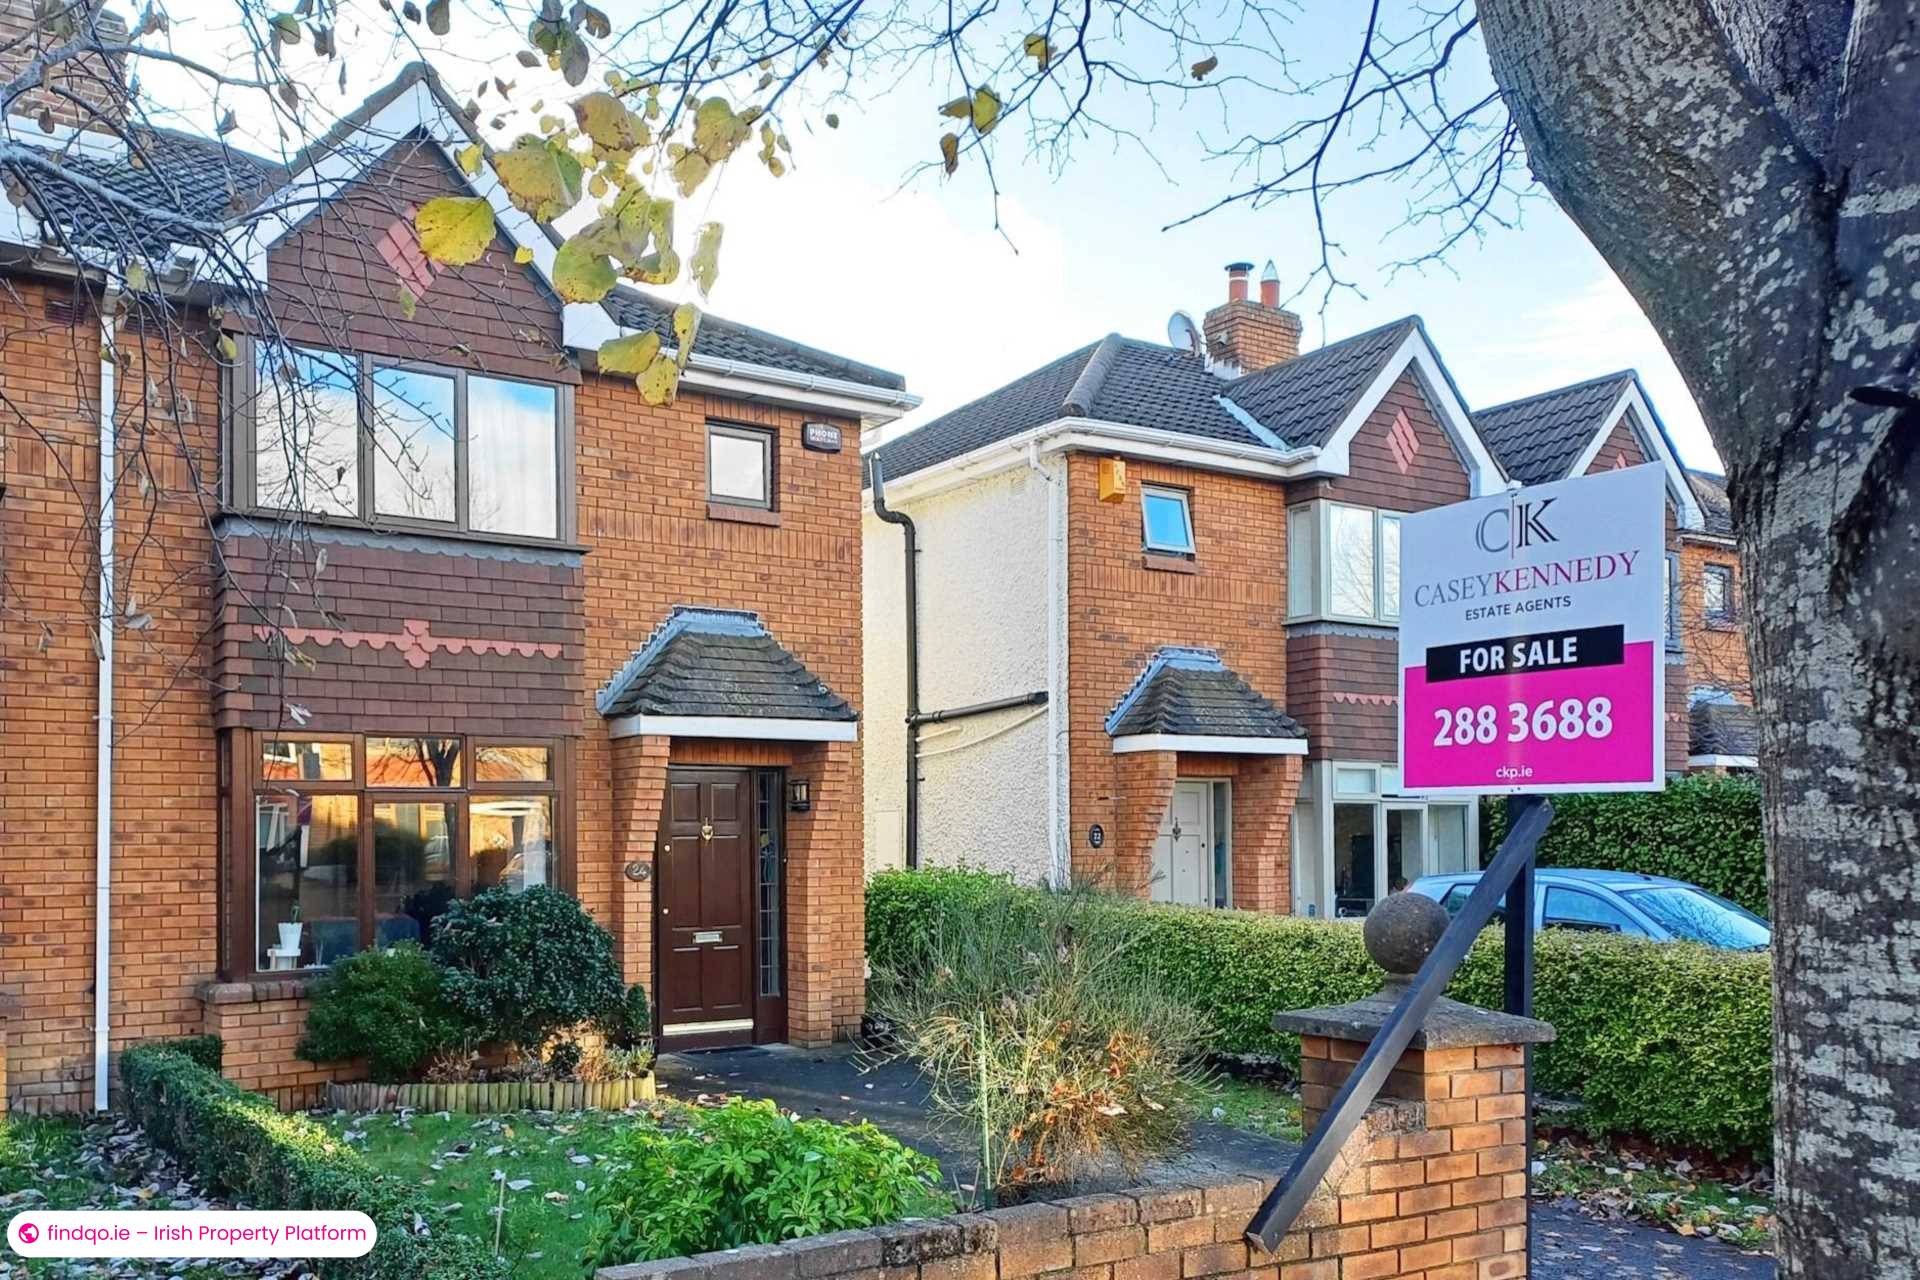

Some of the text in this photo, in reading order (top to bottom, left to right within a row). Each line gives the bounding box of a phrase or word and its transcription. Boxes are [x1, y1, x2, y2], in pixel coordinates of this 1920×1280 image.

[1465, 595, 1572, 621] ESTATE AGENTS
[1459, 636, 1578, 674] FOR SALE
[1433, 697, 1613, 747] 288 3688
[1496, 765, 1533, 779] ckp.ie
